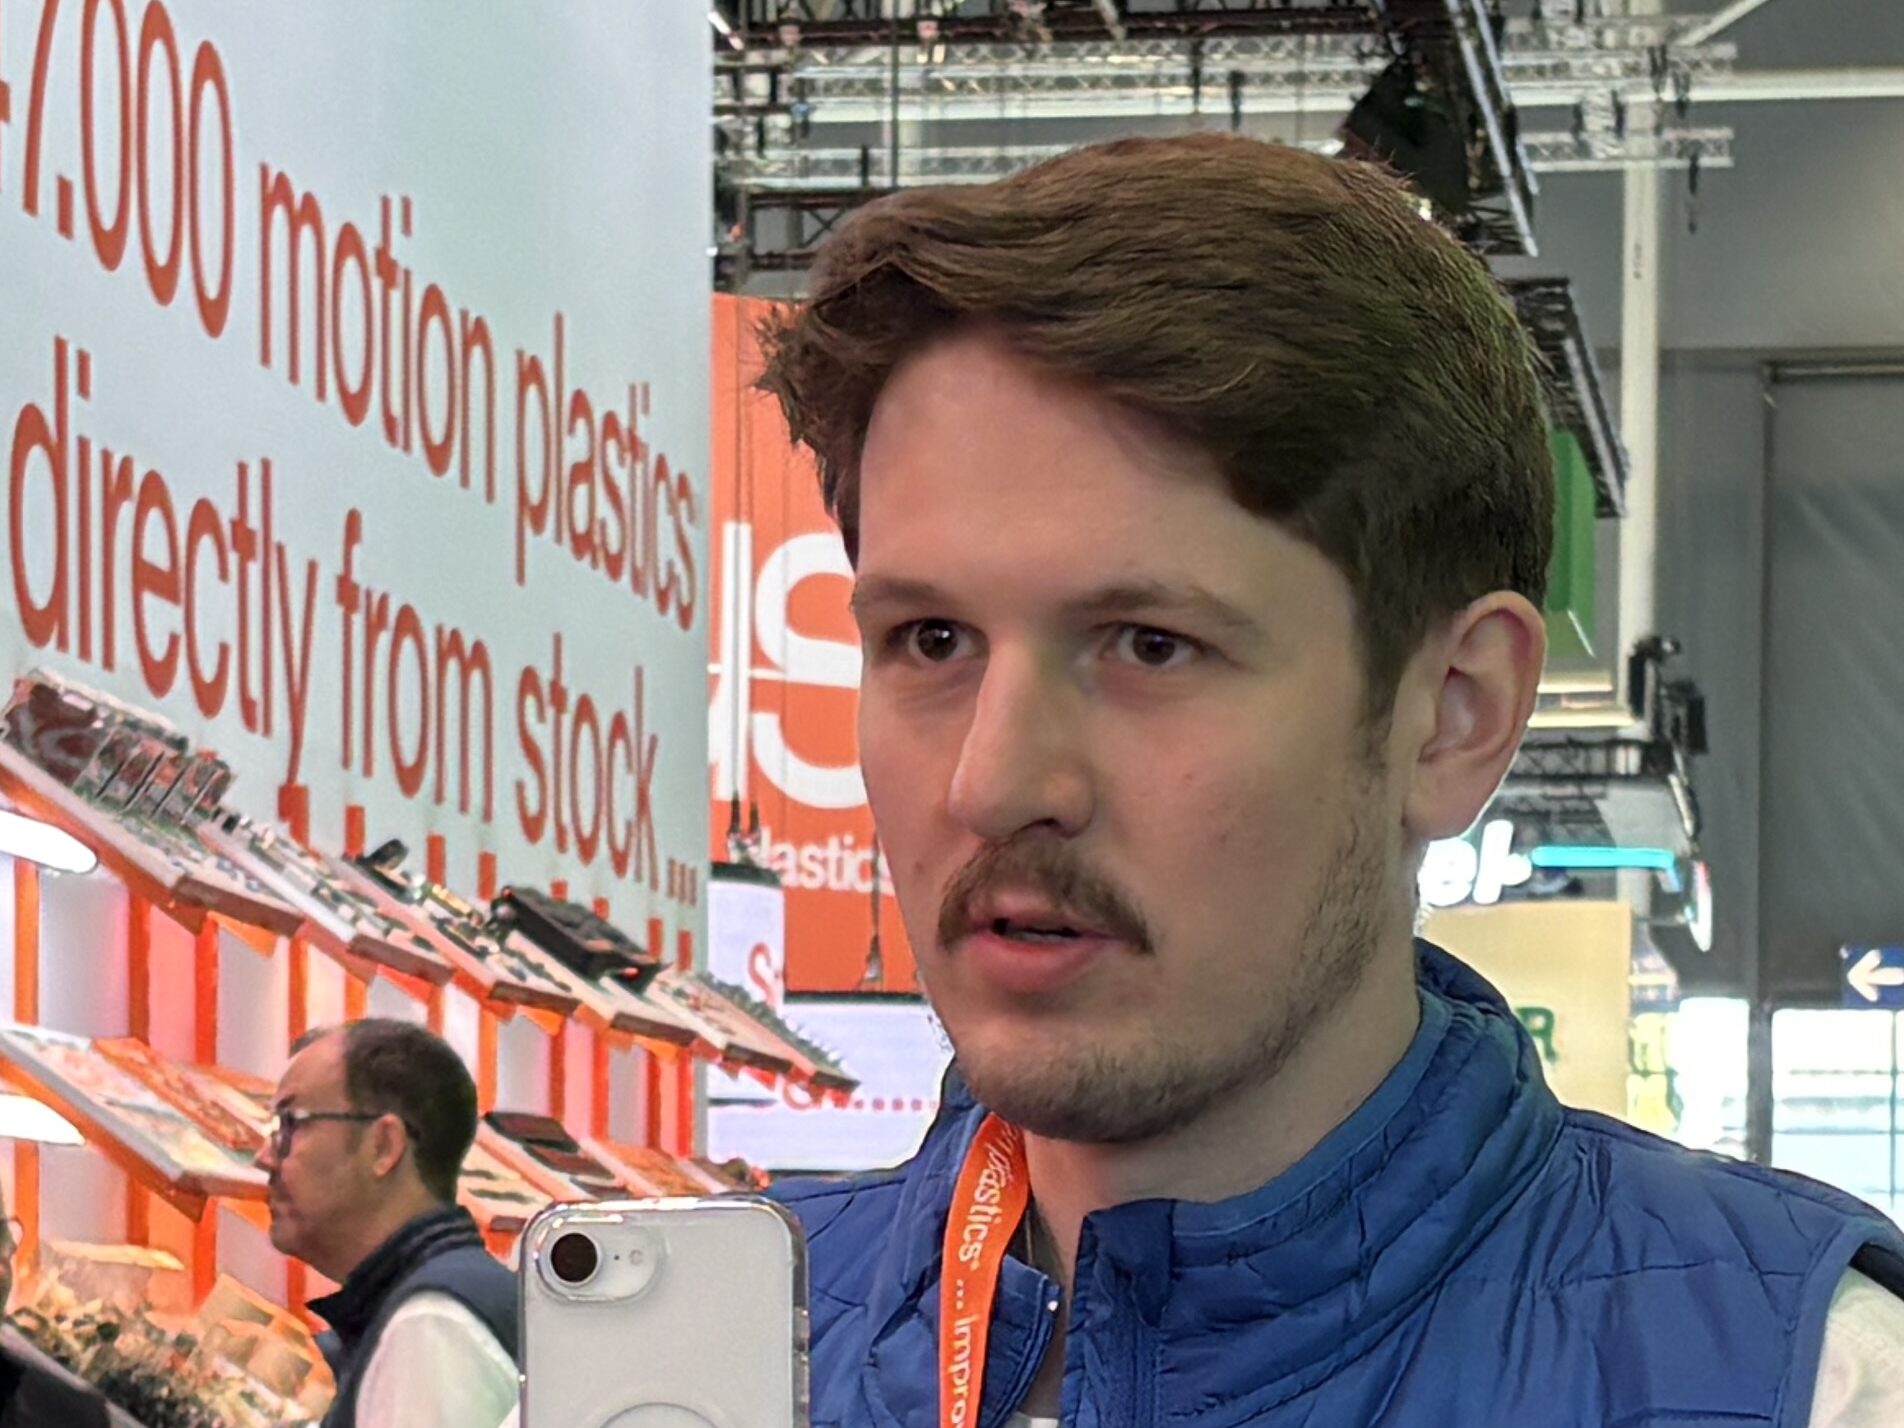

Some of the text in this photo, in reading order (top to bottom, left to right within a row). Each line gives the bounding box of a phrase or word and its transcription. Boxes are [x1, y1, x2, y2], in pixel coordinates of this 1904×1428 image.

[9, 336, 317, 785] directly
[336, 508, 492, 824] from
[515, 632, 659, 893] stock
[259, 160, 495, 504] motion
[515, 311, 698, 631] plastics
